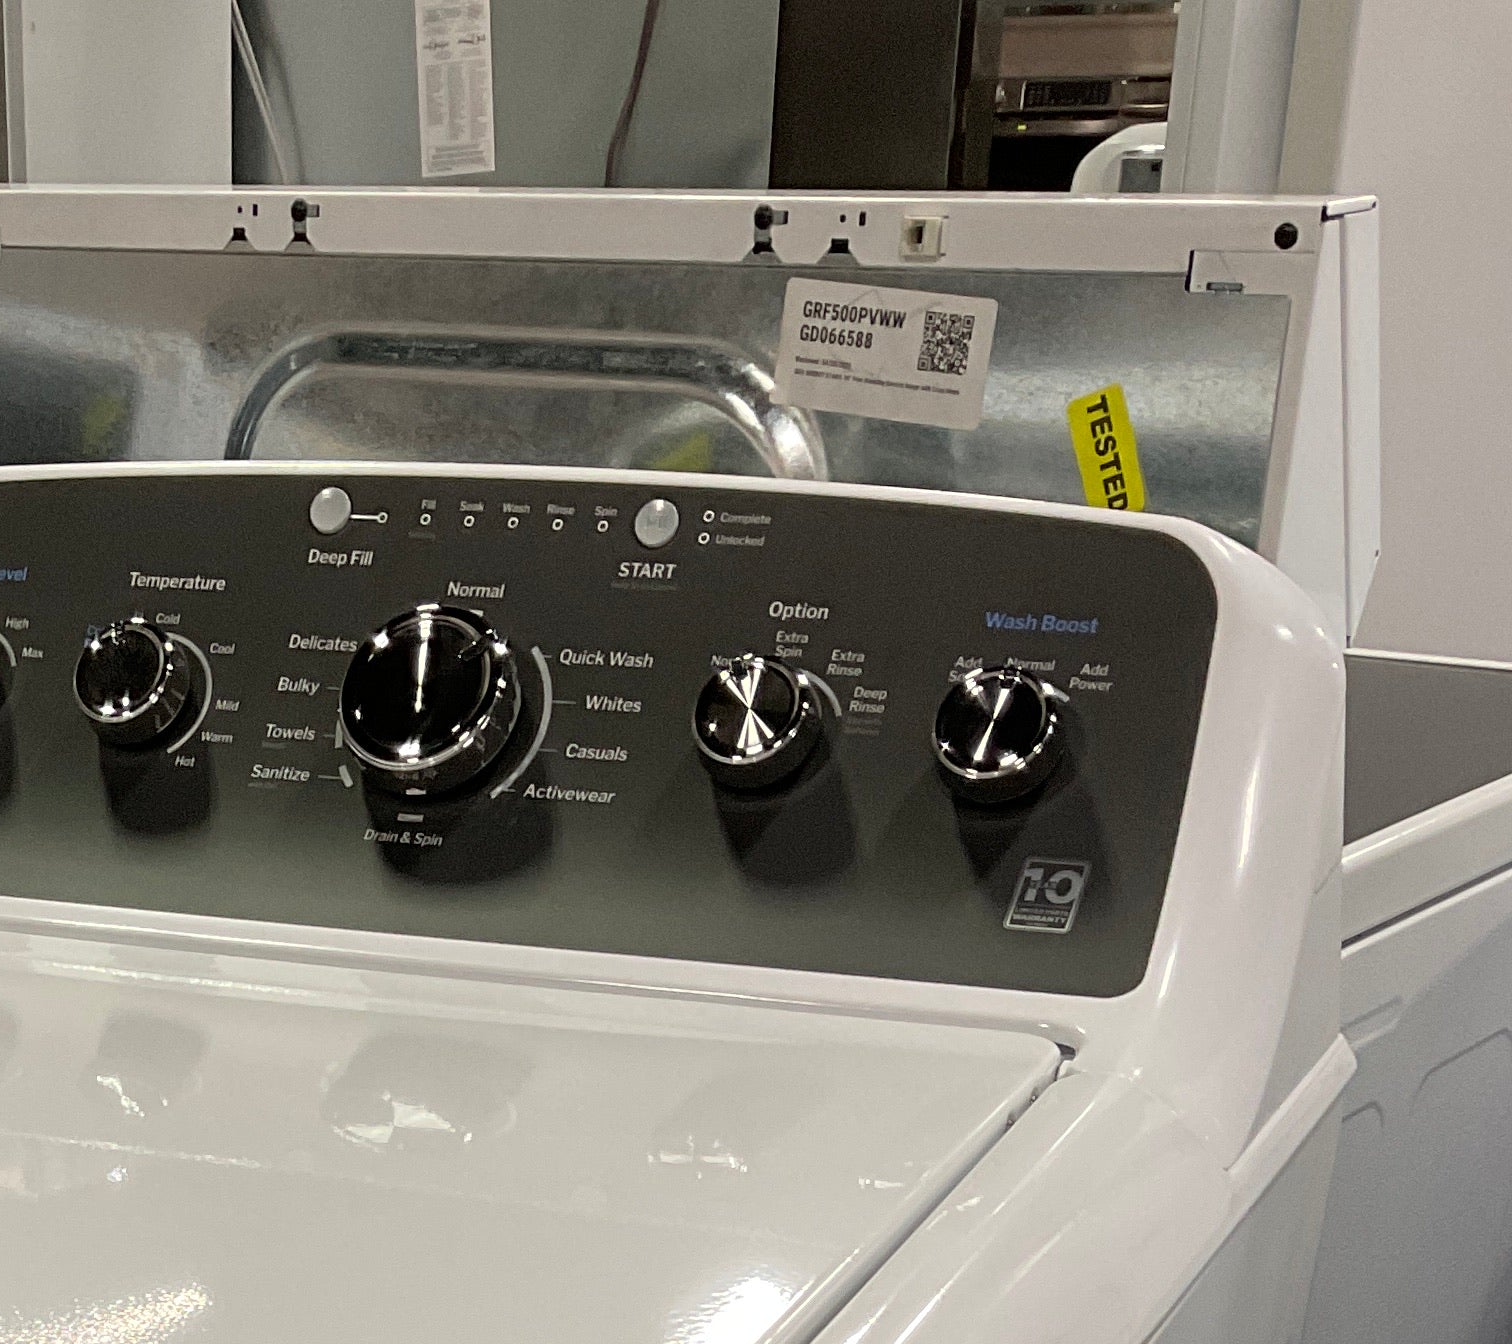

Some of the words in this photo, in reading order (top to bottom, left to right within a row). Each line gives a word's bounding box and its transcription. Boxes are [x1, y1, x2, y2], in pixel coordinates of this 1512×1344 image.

[803, 301, 907, 328] GRF500PVWW
[800, 325, 873, 349] GD066588
[1087, 394, 1128, 510] TESTED
[595, 506, 618, 518] Spin
[720, 512, 772, 526] Complete
[715, 534, 766, 547] Unlocked
[308, 548, 347, 567] Deep
[350, 550, 373, 566] Fill
[618, 562, 677, 579] START
[130, 572, 226, 591] Temperature
[447, 581, 505, 599] Normal
[769, 601, 829, 620] Option
[5, 616, 30, 630] High
[155, 612, 181, 625] Cold
[985, 611, 1037, 630] Wash
[1040, 614, 1099, 633] Boost
[289, 634, 358, 652] Delicates
[776, 631, 809, 644] Extra
[22, 647, 44, 659] Max
[210, 642, 236, 655] Cool
[775, 645, 803, 659] Spin
[560, 649, 605, 666] Quick
[609, 651, 654, 668] Wash
[831, 649, 865, 663] Extra
[954, 655, 983, 669] Add
[826, 663, 863, 677] Rinse
[1007, 657, 1056, 671] Normal
[1080, 663, 1110, 676] Add
[277, 676, 320, 696] Bulky
[1069, 677, 1114, 691] Power
[854, 686, 888, 701] Deep
[215, 699, 240, 712] Mild
[585, 695, 642, 713] Whites
[849, 700, 885, 714] Rinse
[201, 731, 233, 743] Warm
[266, 723, 316, 741] Towels
[565, 743, 628, 761] Casuals
[174, 756, 196, 768] Hot
[250, 764, 310, 782] Sanitize
[523, 783, 616, 804] Activewear
[363, 828, 398, 843] Drain
[399, 831, 411, 844] &
[413, 832, 443, 847] Spin
